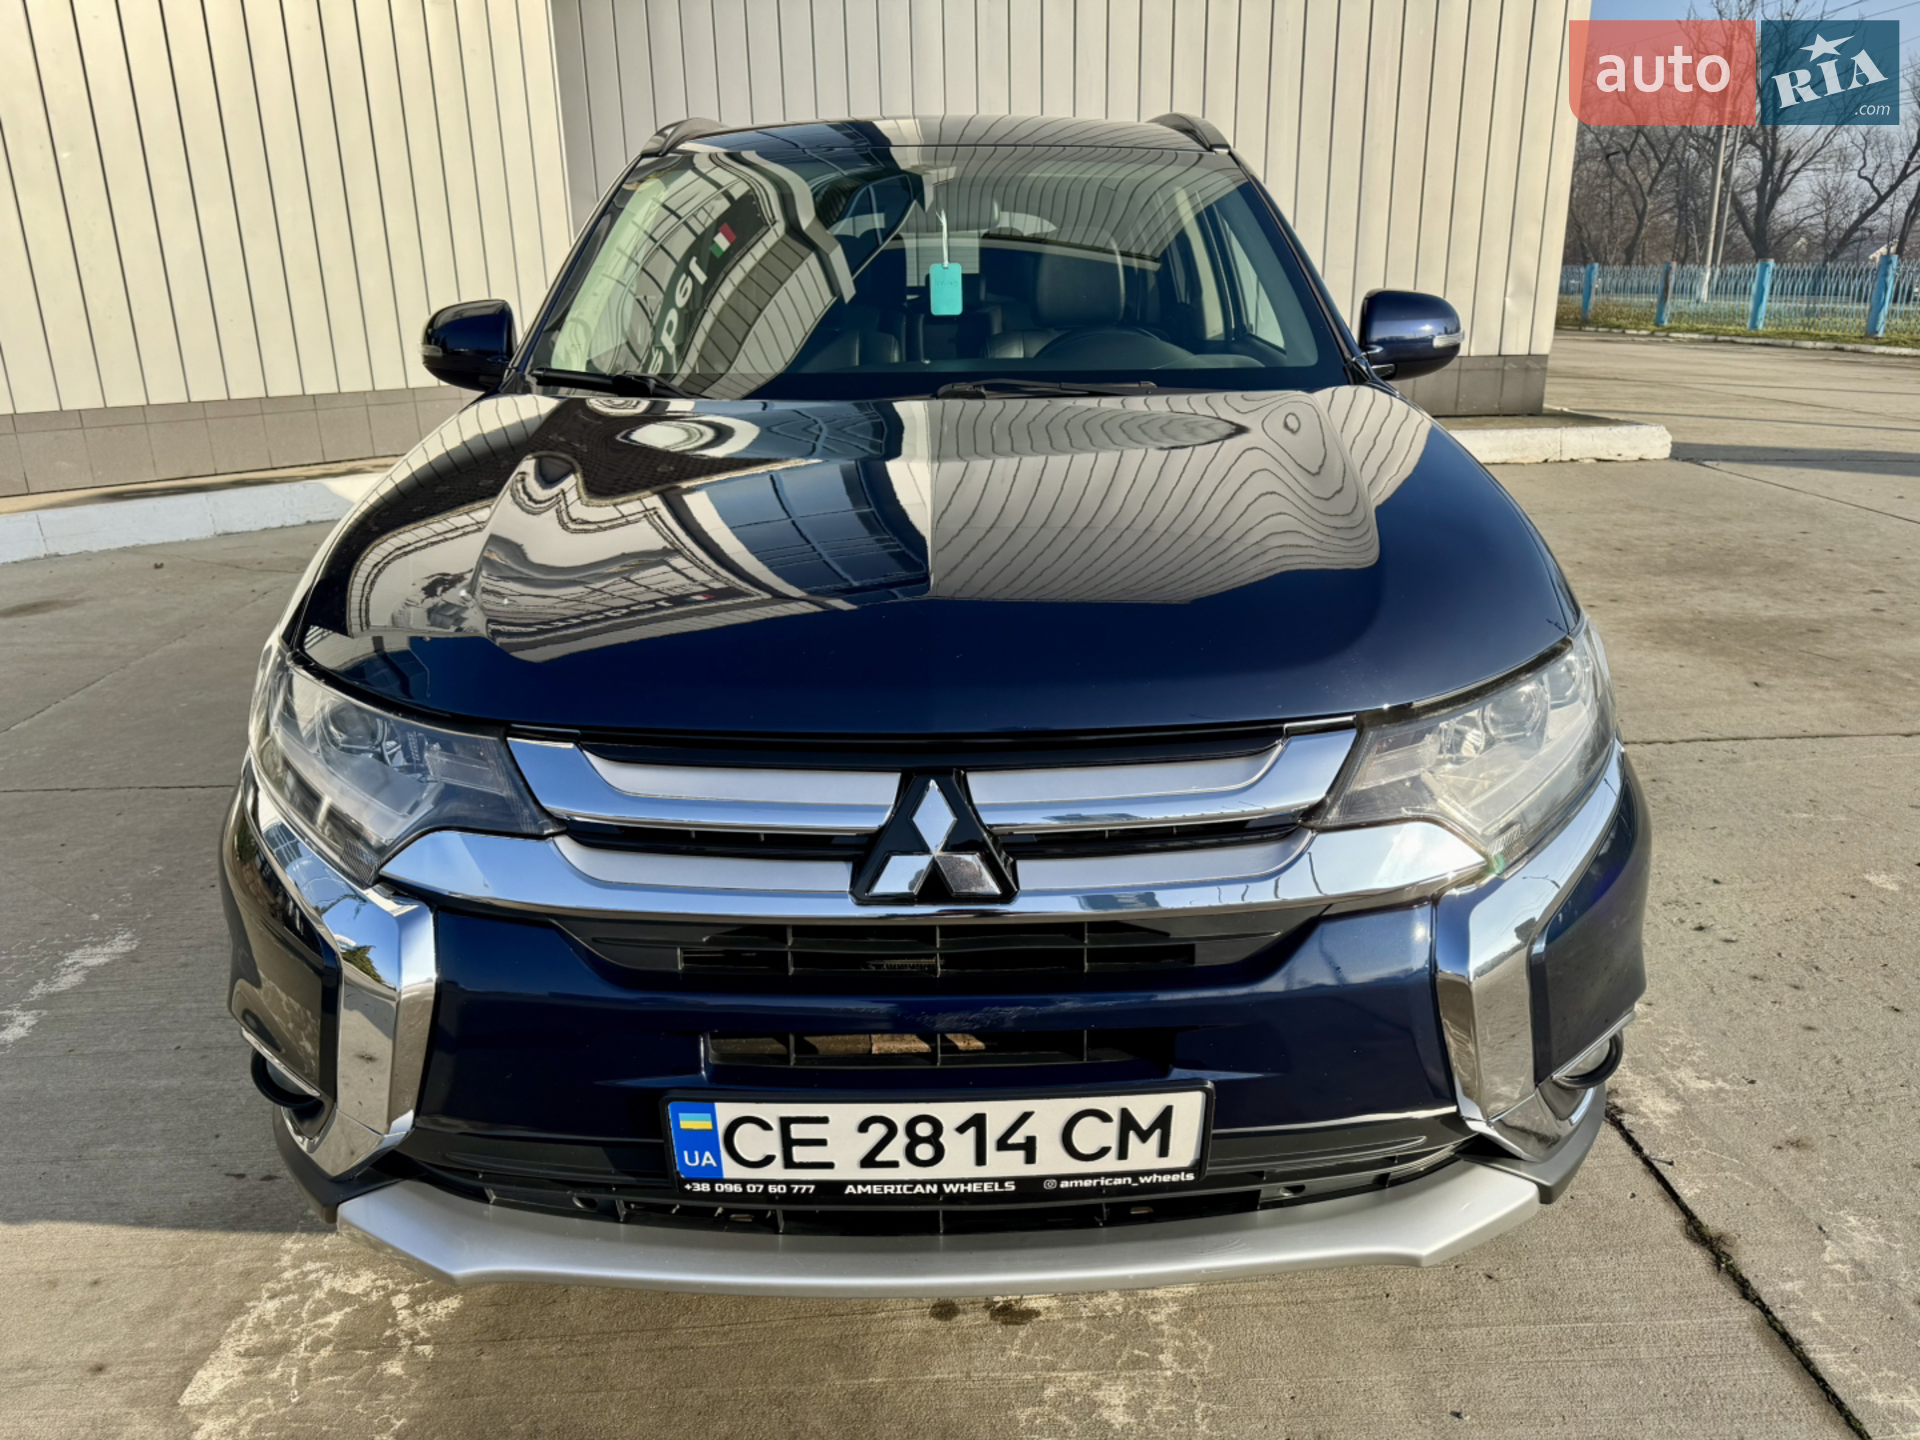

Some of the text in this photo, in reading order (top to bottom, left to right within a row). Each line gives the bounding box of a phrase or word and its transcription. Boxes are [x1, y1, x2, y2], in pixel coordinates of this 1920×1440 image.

[723, 1104, 1175, 1170] CE 2814 CM
[683, 1149, 717, 1168] UA
[684, 1182, 816, 1195] +38 096 07 60 777
[844, 1181, 1017, 1195] AMERICAN WHEELS
[1059, 1171, 1196, 1189] american_wheels
